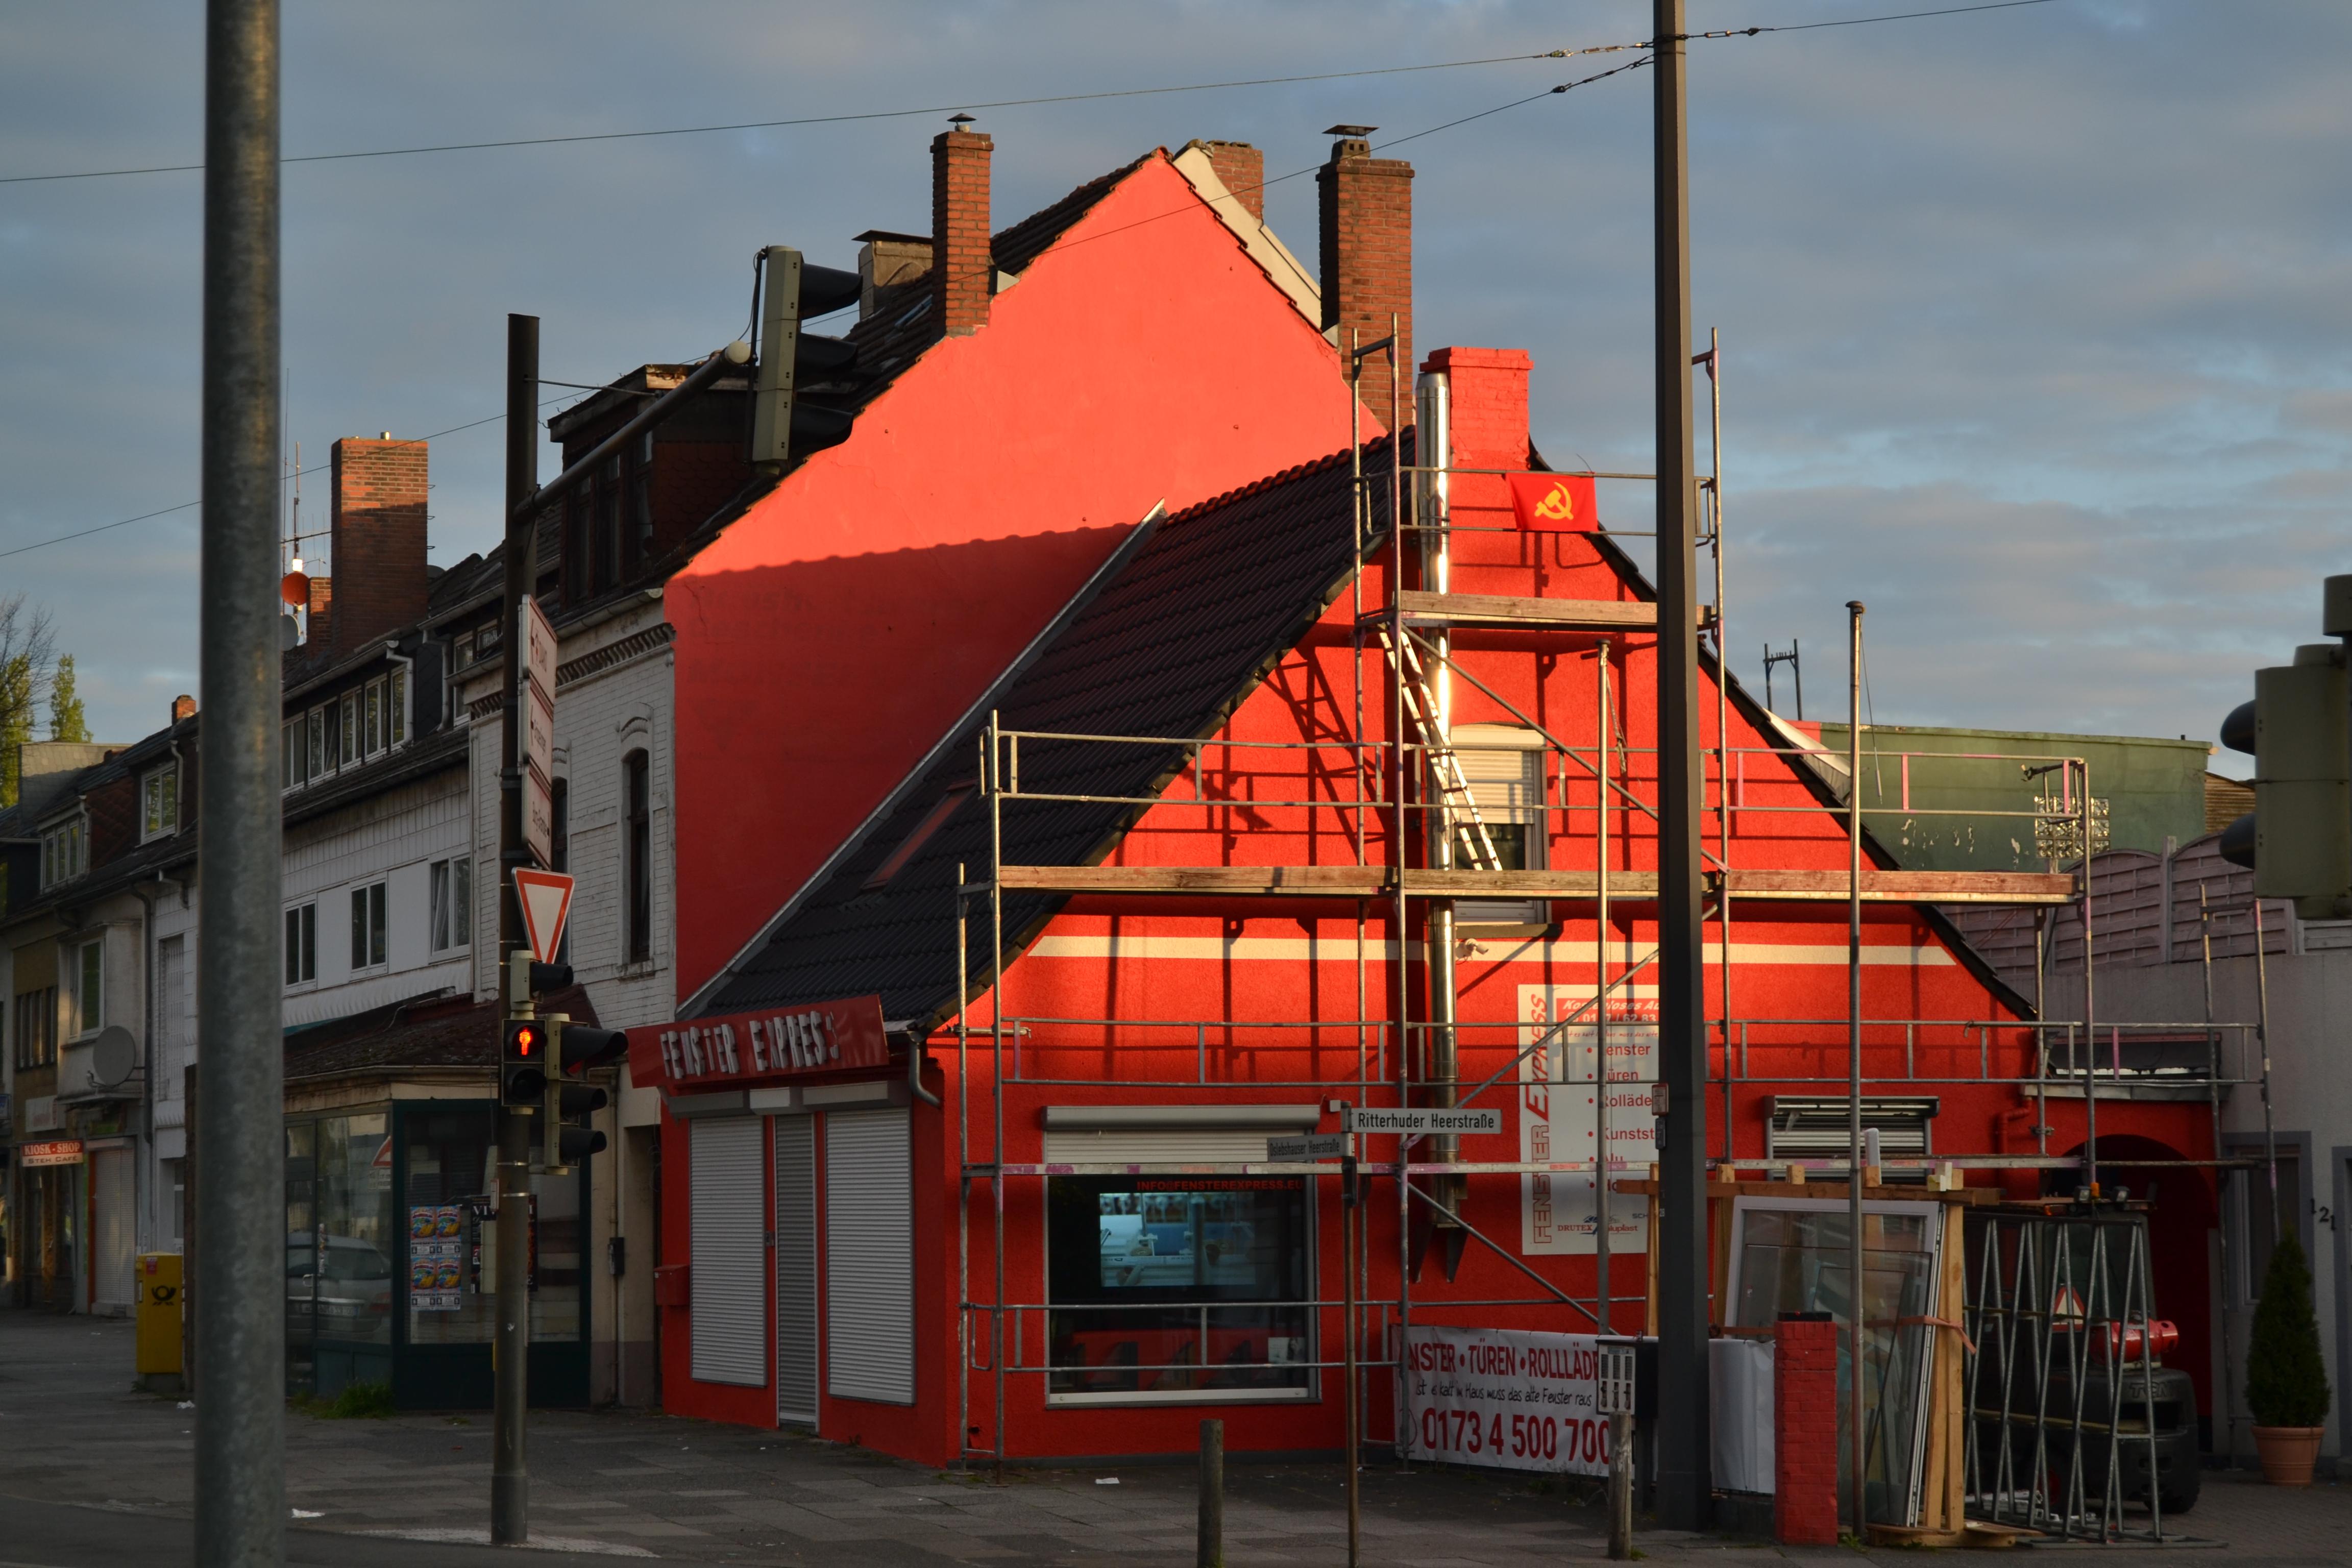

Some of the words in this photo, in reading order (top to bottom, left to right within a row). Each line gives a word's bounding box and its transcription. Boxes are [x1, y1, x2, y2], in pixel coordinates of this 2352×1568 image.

[1606, 1044, 1651, 1056] enster
[1607, 1068, 1639, 1081] üren
[1358, 1112, 1425, 1129] Ritterhuder
[1431, 1114, 1494, 1129] Heerstraße
[24, 1144, 51, 1156] KIOSK
[57, 1142, 81, 1153] SHOP
[1269, 1142, 1306, 1157] Oslebshauser
[1308, 1139, 1340, 1154] Heerstraße
[1136, 1180, 1303, 1191] INFO@FENSTEREXPRESS.EU
[1531, 1124, 1552, 1243] FENSER
[2310, 1198, 2337, 1231] 121
[1400, 1342, 1456, 1373] NSTER
[1468, 1338, 1515, 1376] TÜREN
[1416, 1379, 1427, 1396] Ist
[1465, 1382, 1484, 1400] Haus
[1487, 1388, 1505, 1401] muss
[1508, 1387, 1522, 1402] das
[1525, 1385, 1539, 1403] alte
[1542, 1387, 1573, 1405] Fenster
[1575, 1394, 1592, 1407] raus
[1423, 1407, 1481, 1454] 0173
[1489, 1413, 1504, 1455] 4
[1512, 1414, 1557, 1460] 500
[1564, 1418, 1609, 1464] 700
